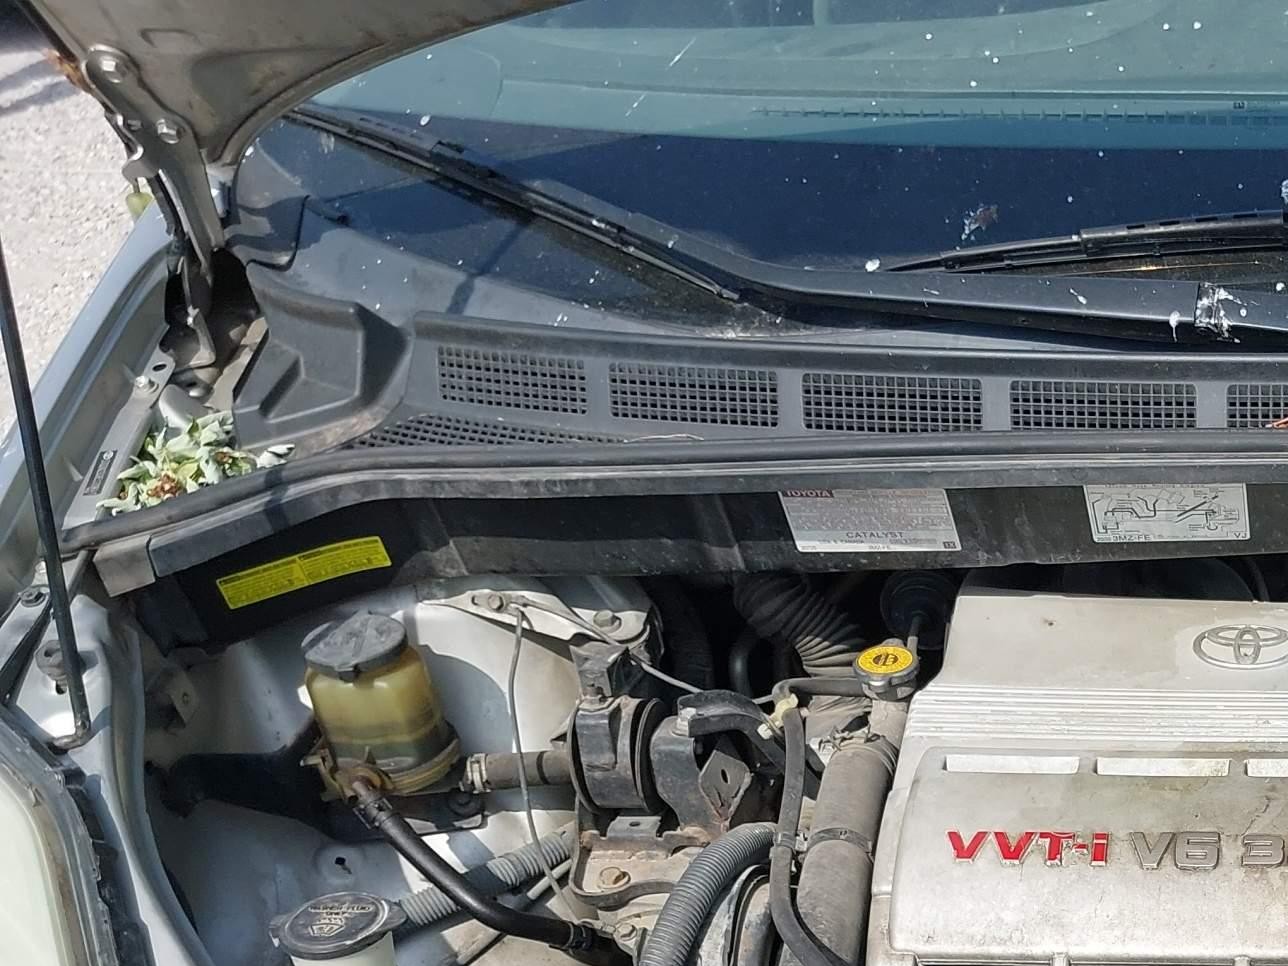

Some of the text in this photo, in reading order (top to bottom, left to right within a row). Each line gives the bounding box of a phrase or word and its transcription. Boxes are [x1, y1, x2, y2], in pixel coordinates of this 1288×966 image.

[845, 531, 904, 539] CATALYST
[945, 830, 1109, 866] VVT-i
[1130, 831, 1221, 869] V6
